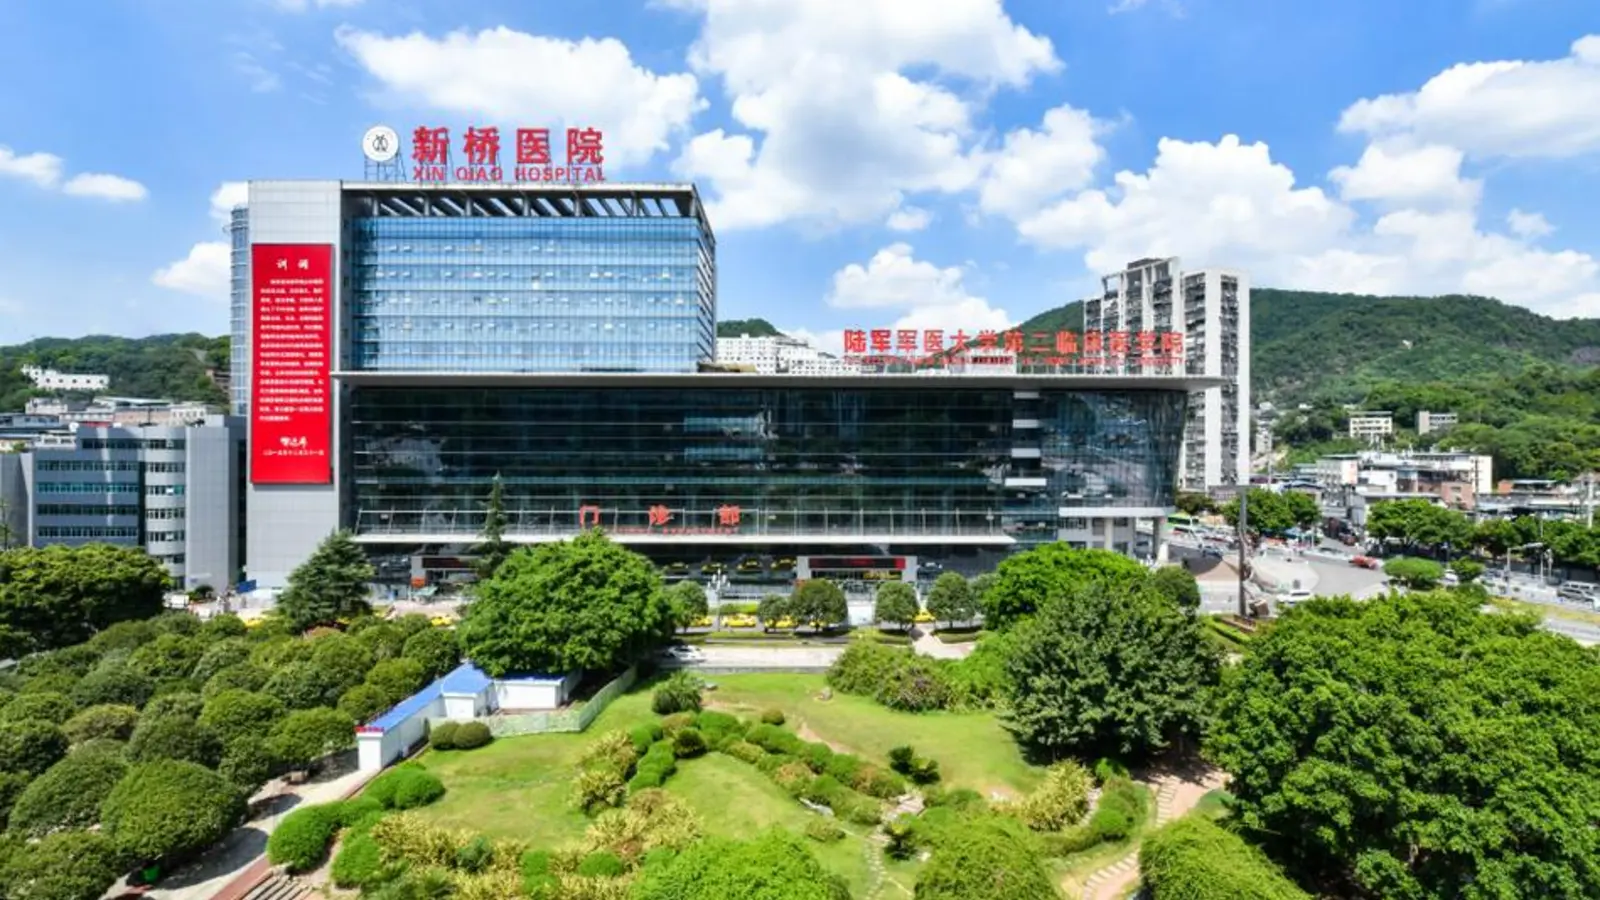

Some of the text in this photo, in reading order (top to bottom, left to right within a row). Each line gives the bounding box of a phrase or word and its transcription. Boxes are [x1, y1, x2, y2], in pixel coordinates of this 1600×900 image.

[411, 126, 605, 165] 新桥医院
[413, 165, 606, 182] XIN QIAO HOSPITAL
[843, 328, 1183, 355] 陆军军医大学第二临床医学院
[579, 505, 740, 526] 门诊部
